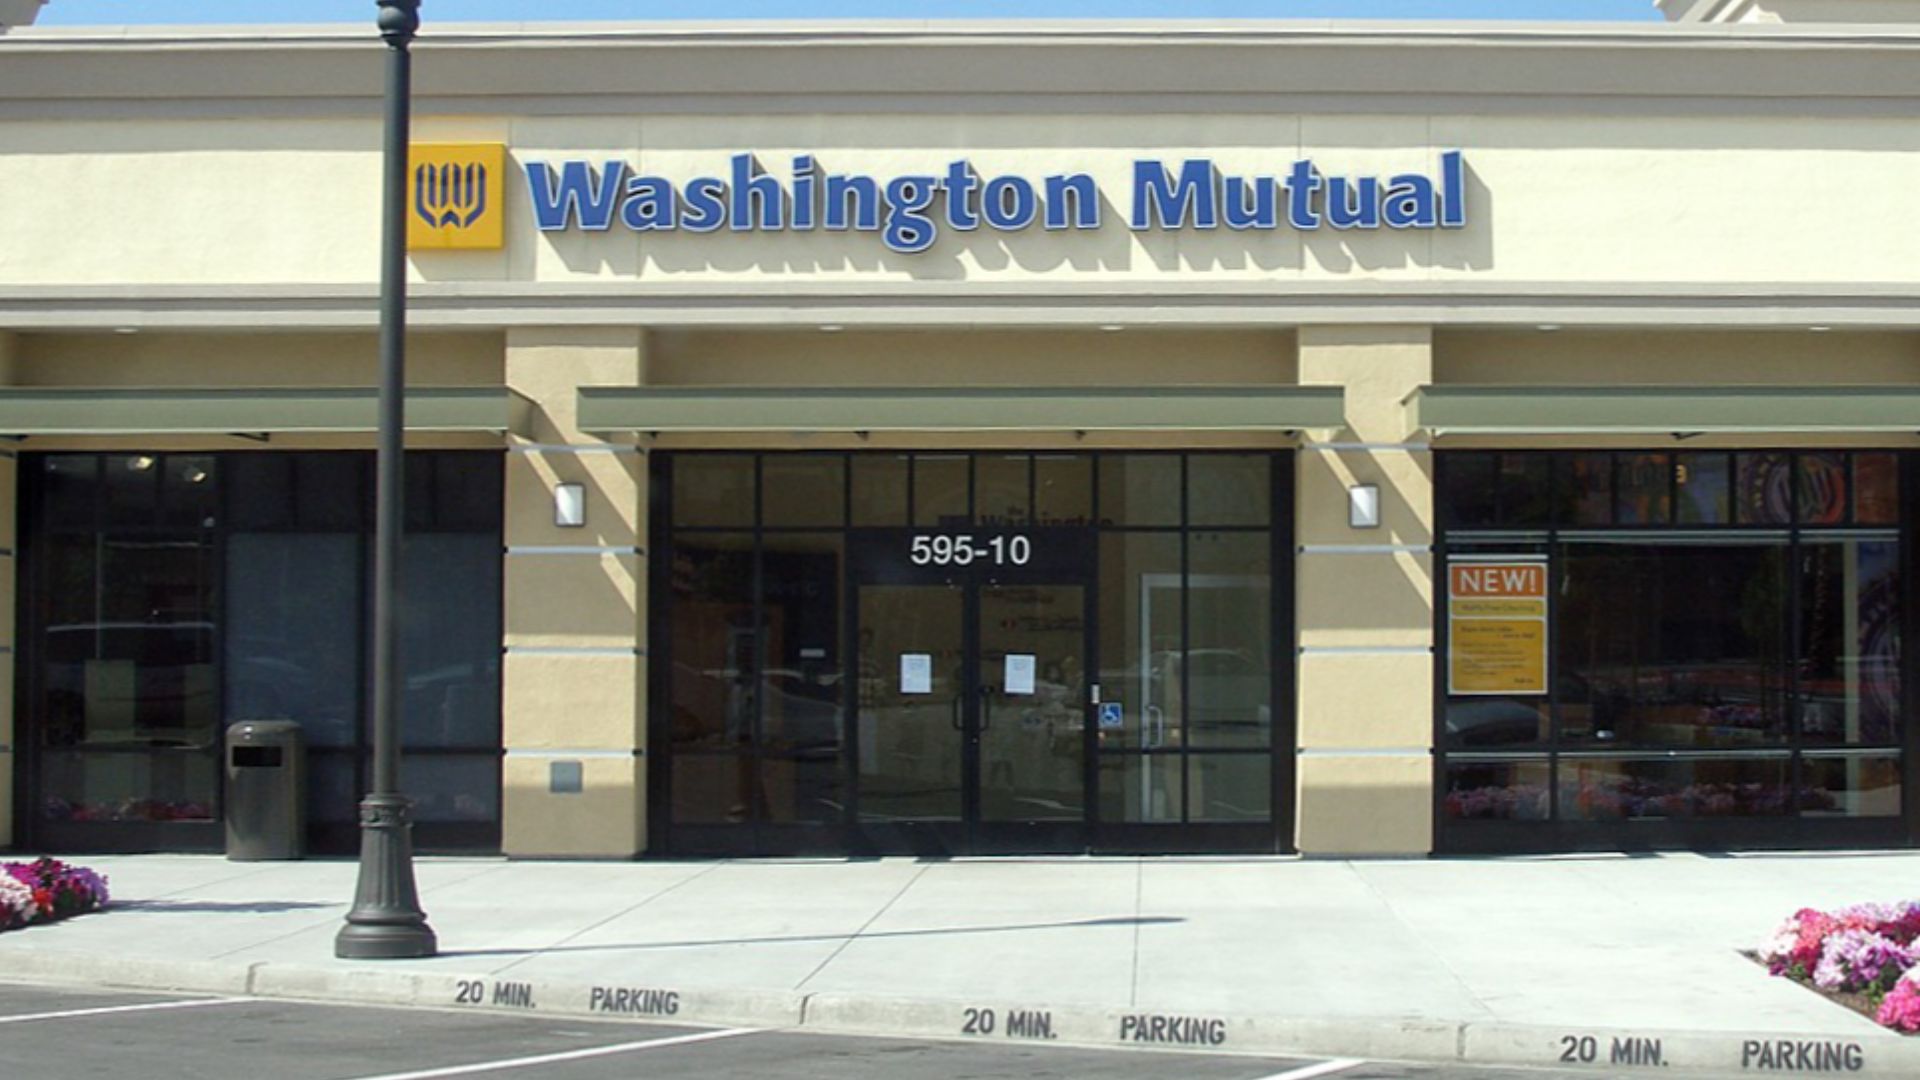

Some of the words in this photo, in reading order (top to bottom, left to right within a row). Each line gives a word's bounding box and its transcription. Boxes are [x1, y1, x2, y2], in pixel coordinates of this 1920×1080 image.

[524, 152, 1100, 253] Washington
[1131, 150, 1466, 231] Mutual
[911, 536, 1031, 564] 595-10
[1460, 569, 1536, 592] NEW!
[456, 980, 484, 1003] 20
[493, 981, 536, 1008] MIN.
[590, 987, 679, 1015] PARKING
[962, 1008, 995, 1034] 20
[1006, 1010, 1057, 1039] MIN.
[1120, 1015, 1226, 1045] PARKING
[1560, 1036, 1597, 1062] 20
[1611, 1037, 1669, 1066] MIN.
[1742, 1040, 1863, 1071] PARKING
